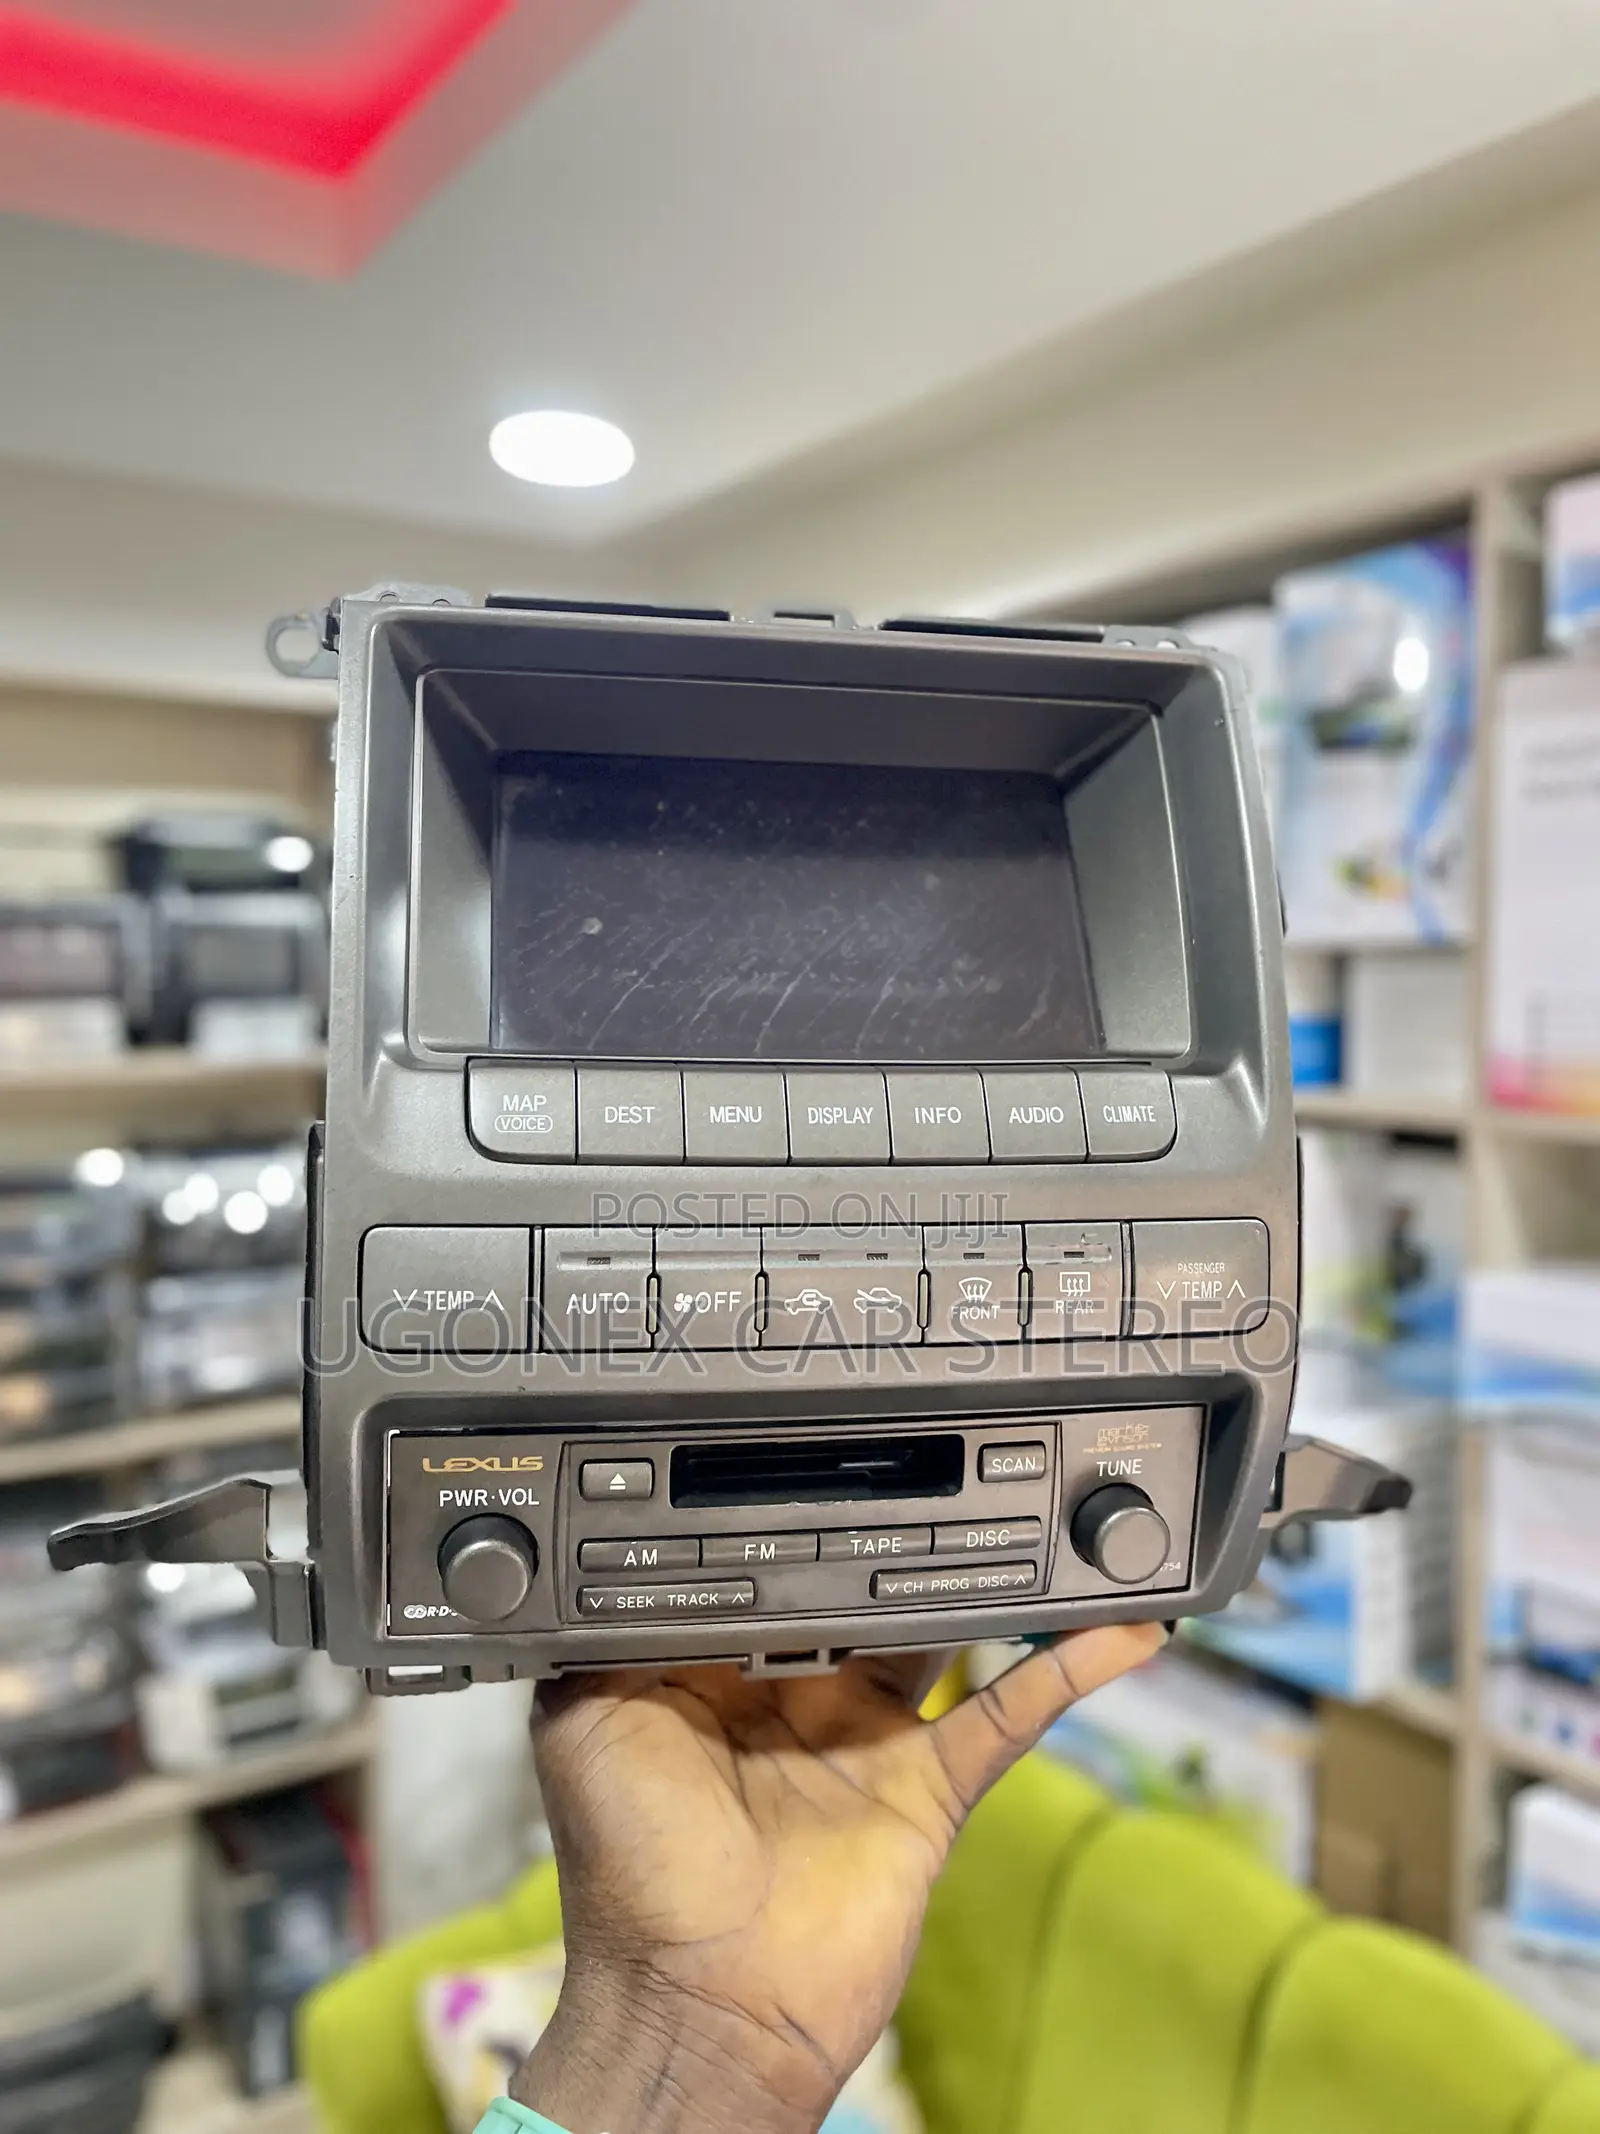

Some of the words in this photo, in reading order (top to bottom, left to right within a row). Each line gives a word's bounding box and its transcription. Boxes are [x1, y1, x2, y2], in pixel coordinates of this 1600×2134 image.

[502, 1094, 547, 1112] MAP
[604, 1106, 655, 1125] DEST
[709, 1106, 763, 1124] MENU
[807, 1107, 874, 1125] DISPLAY
[914, 1107, 962, 1124] INFO
[1008, 1106, 1064, 1124] AUDIO
[1102, 1105, 1156, 1123] CLIMATE
[500, 1116, 547, 1131] VOICE
[1177, 1262, 1225, 1274] PASSENGER
[1181, 1281, 1223, 1299] TEMP
[423, 1290, 475, 1311] TEMP
[565, 1292, 630, 1315] AUTO
[696, 1291, 743, 1313] OFF
[1055, 1299, 1094, 1314] REAR
[951, 1305, 1000, 1320] FRONT
[422, 1456, 544, 1473] LEXUS
[991, 1457, 1037, 1473] SCAN
[1096, 1458, 1143, 1477] TUNE
[850, 1536, 902, 1555] TAPE
[966, 1530, 1011, 1548] DISC
[623, 1549, 659, 1567] AM
[744, 1543, 776, 1561] FM
[903, 1581, 923, 1594] CH
[931, 1579, 970, 1592] PROG
[978, 1575, 1009, 1588] DISC
[616, 1596, 655, 1609] SEEK
[667, 1592, 719, 1606] TRACK
